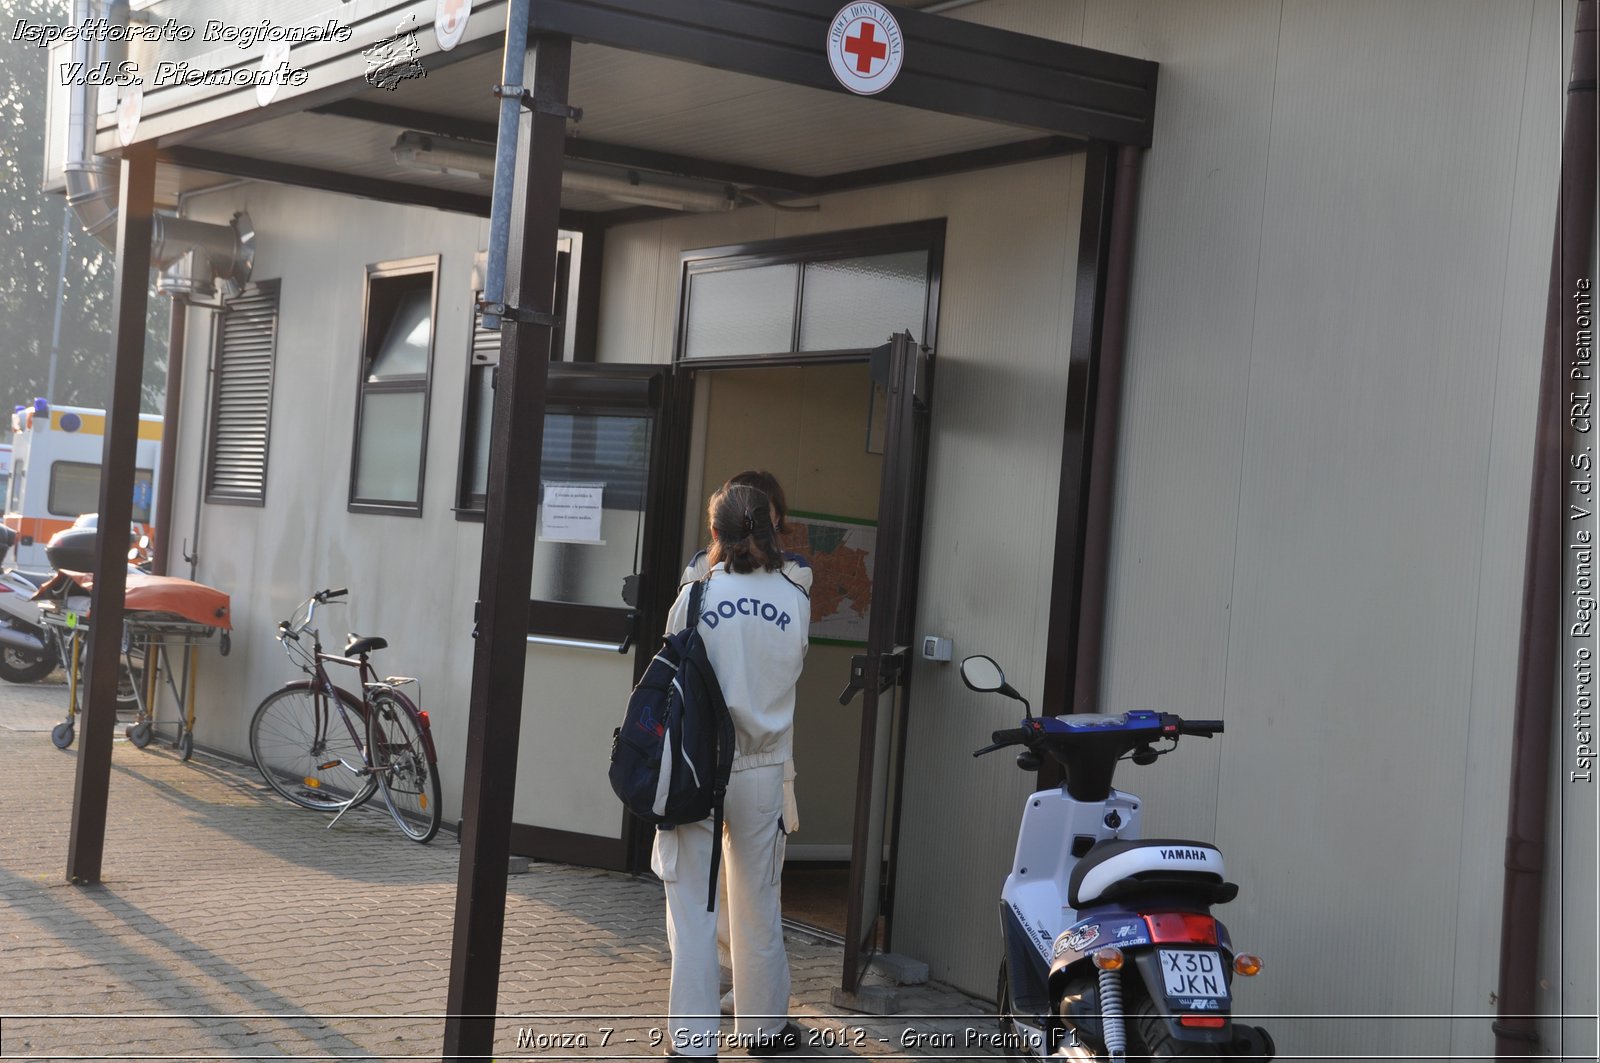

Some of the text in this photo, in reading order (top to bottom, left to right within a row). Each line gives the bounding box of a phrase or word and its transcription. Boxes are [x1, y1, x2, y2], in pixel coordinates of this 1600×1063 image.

[832, 13, 849, 43] CROCE
[850, 4, 877, 18] ROSSA
[701, 597, 791, 632] DOCTOR
[1160, 849, 1207, 861] YAMAHA
[1168, 952, 1214, 973] X3D
[1173, 974, 1219, 995] JKN
